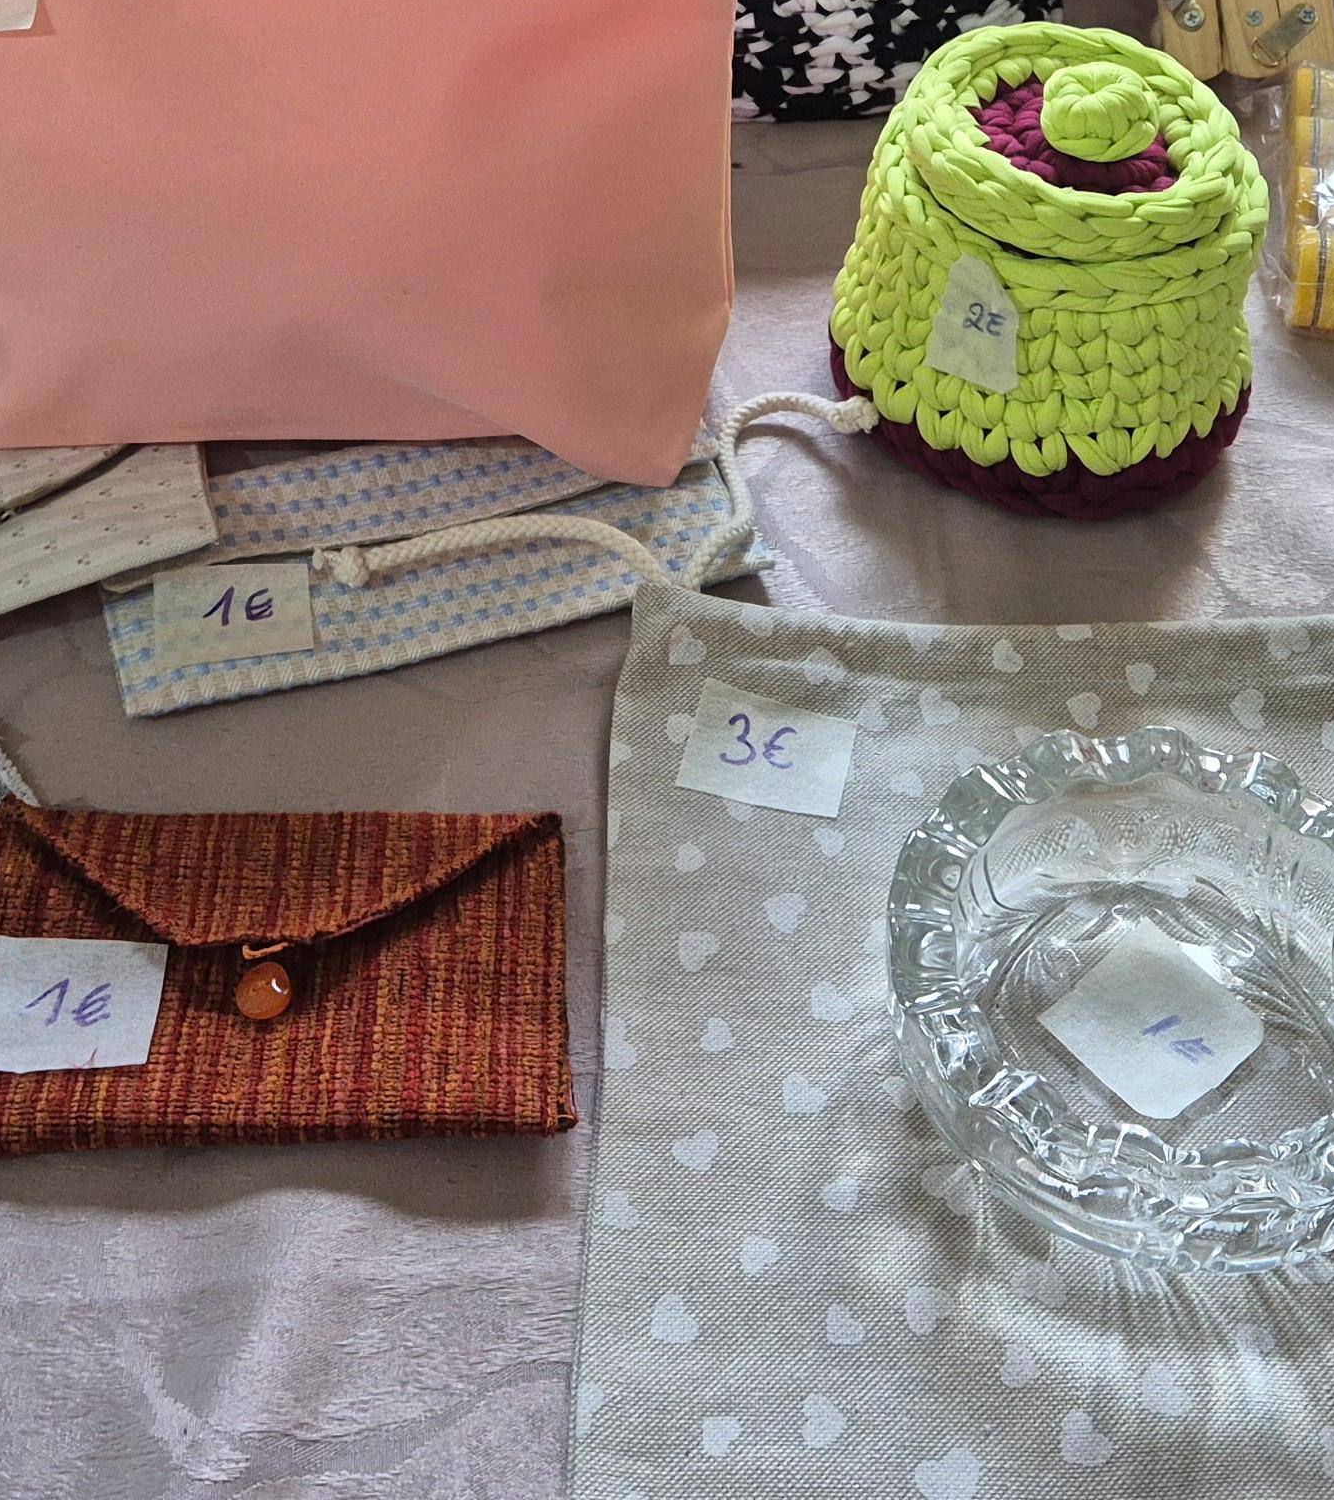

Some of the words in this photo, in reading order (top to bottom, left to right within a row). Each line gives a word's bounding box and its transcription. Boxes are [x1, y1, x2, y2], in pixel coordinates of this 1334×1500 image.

[202, 586, 274, 627] 1€
[719, 713, 798, 770] 3€
[27, 977, 112, 1027] 1€
